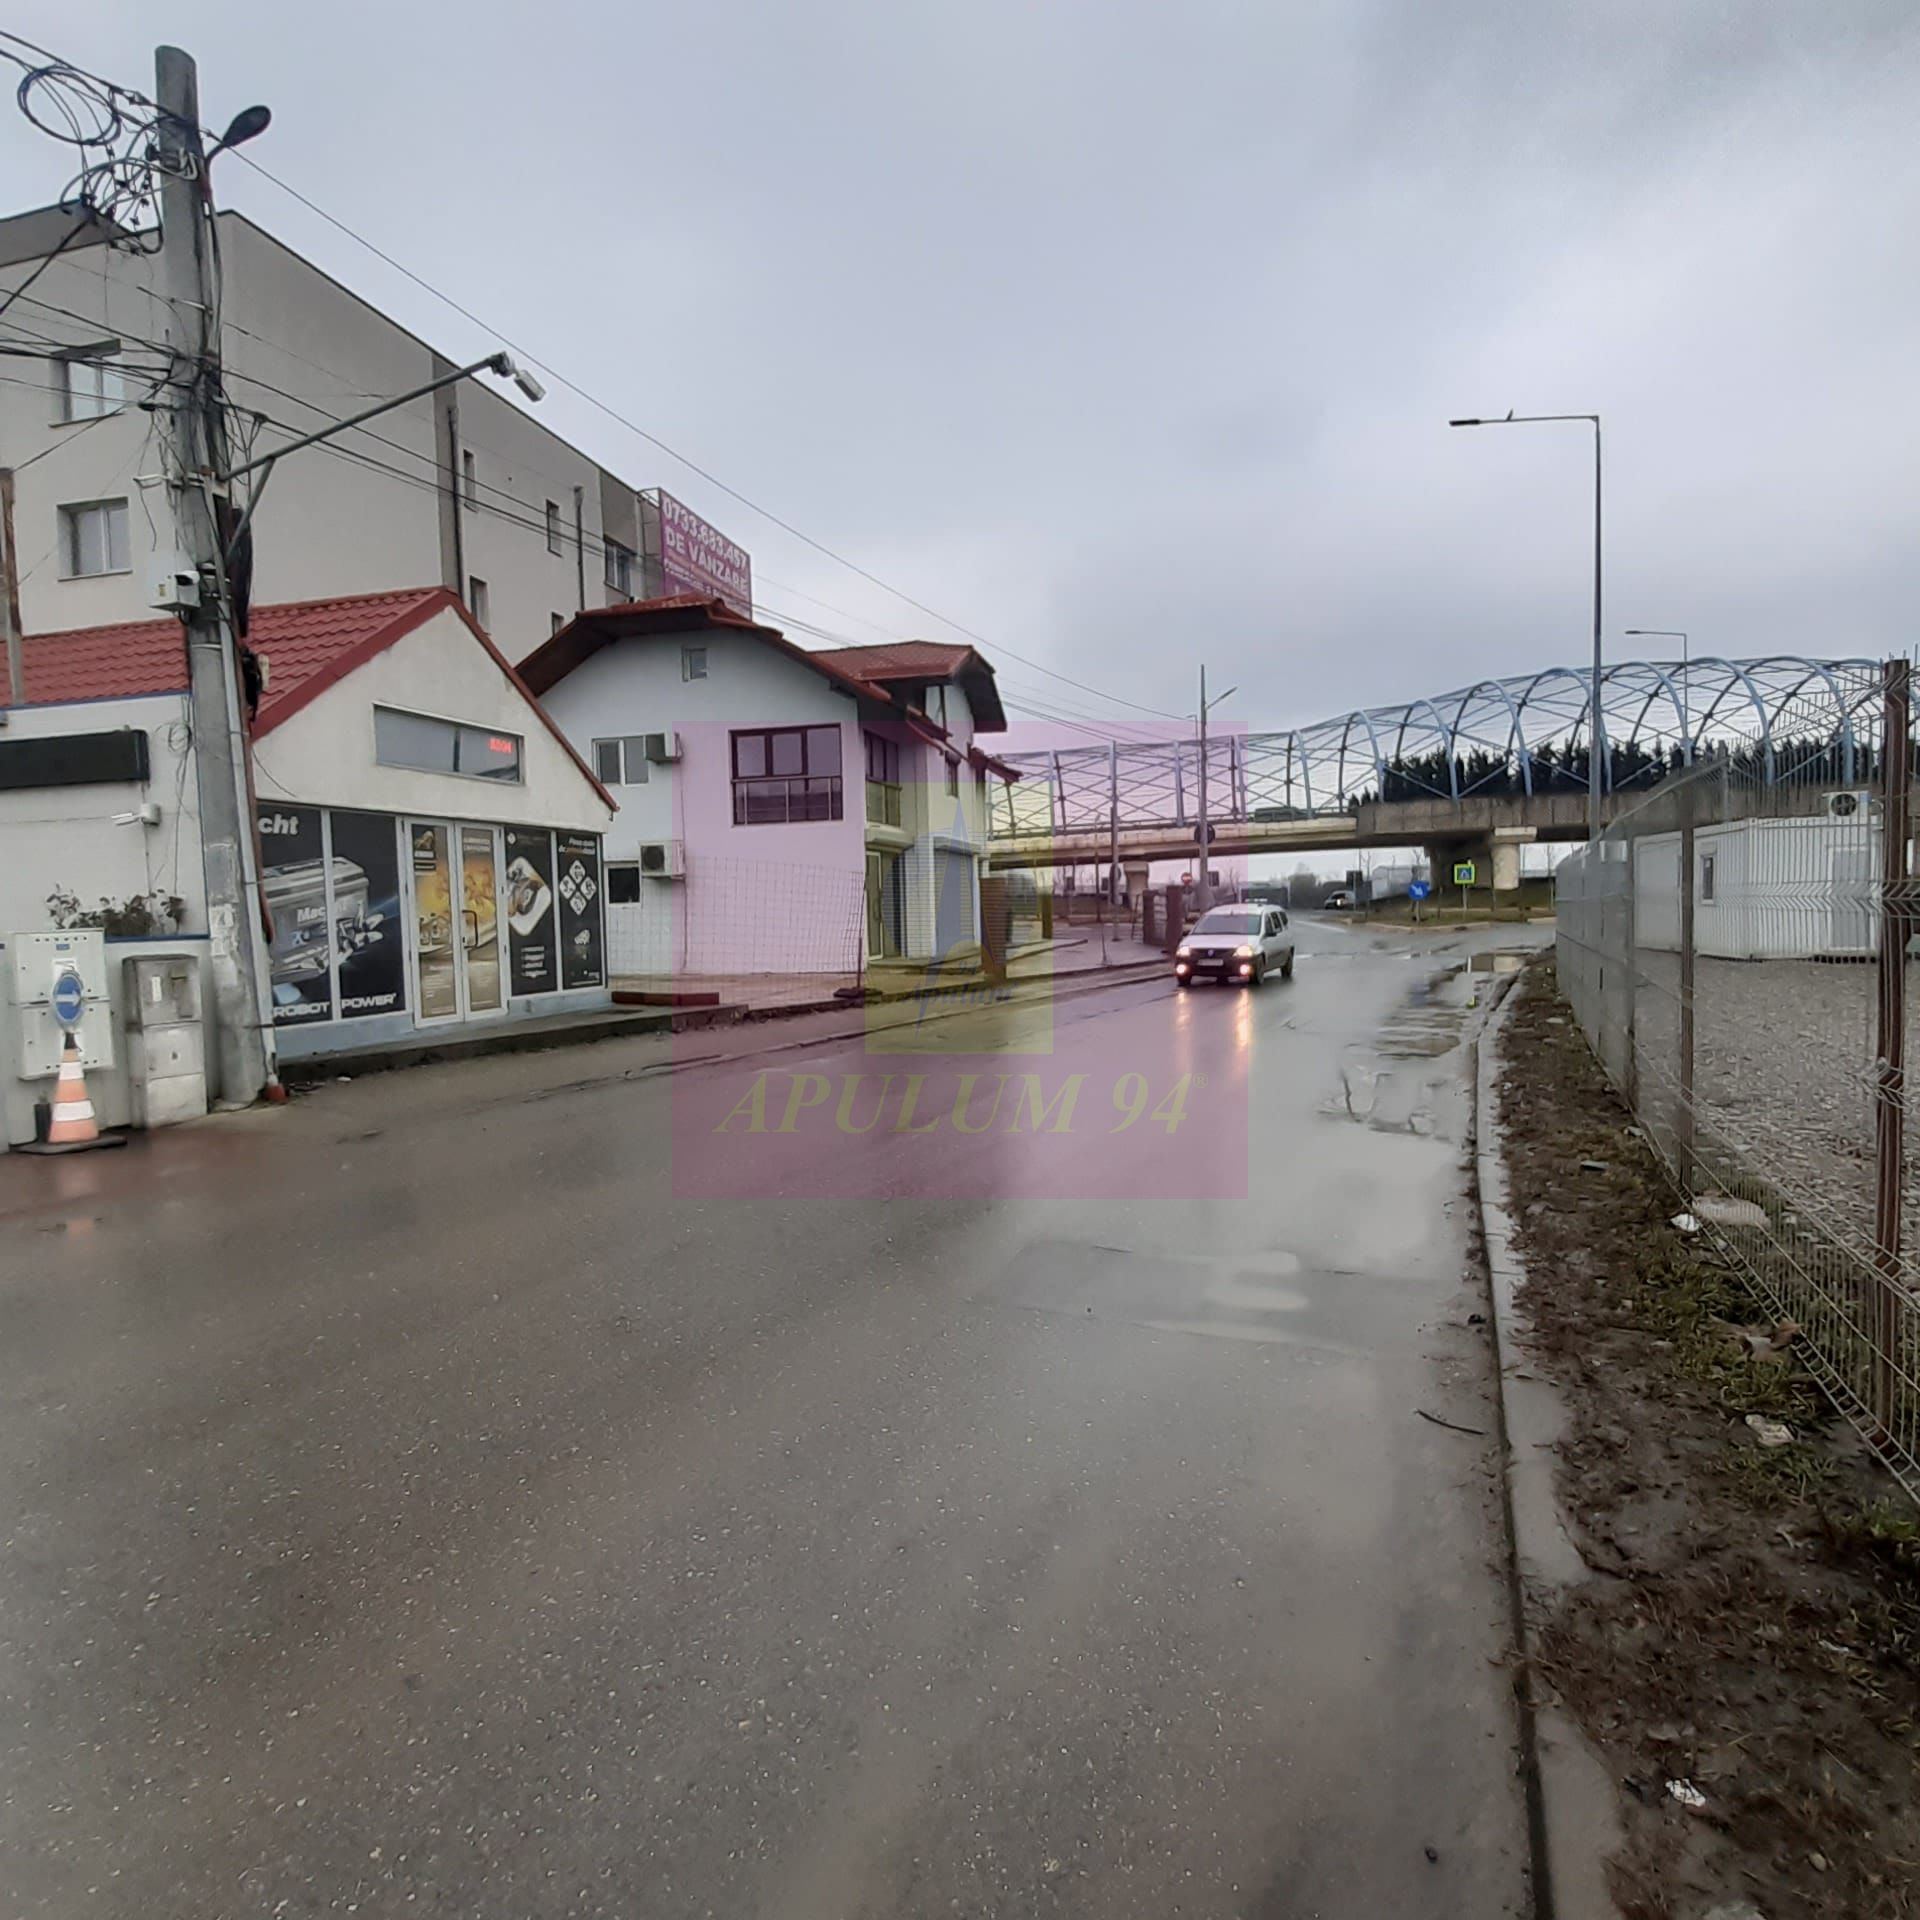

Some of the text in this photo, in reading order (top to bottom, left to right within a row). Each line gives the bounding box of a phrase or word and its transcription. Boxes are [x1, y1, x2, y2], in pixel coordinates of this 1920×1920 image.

[665, 526, 686, 553] DE
[273, 993, 396, 1018] ROBOT POWER
